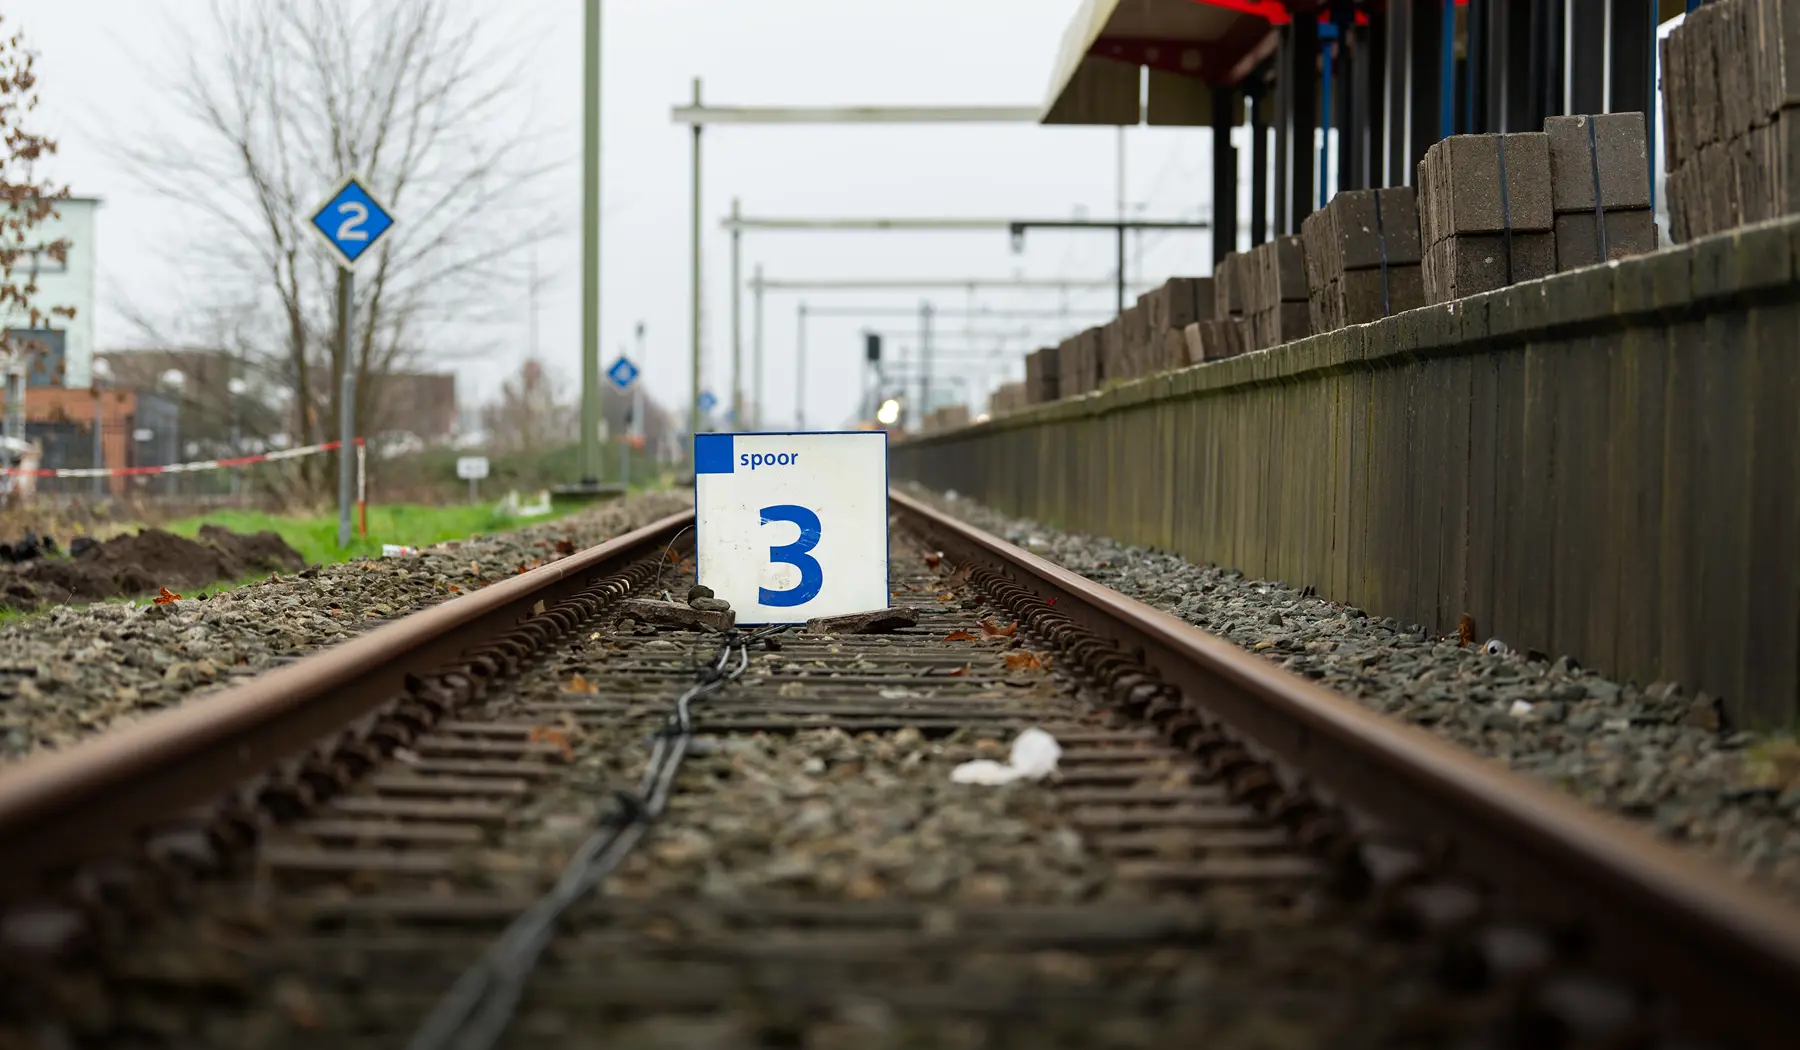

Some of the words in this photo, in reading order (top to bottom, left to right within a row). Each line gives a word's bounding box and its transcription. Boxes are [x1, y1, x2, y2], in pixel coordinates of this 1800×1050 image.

[337, 202, 369, 240] 2
[740, 452, 798, 470] spoor
[758, 504, 823, 607] 3
